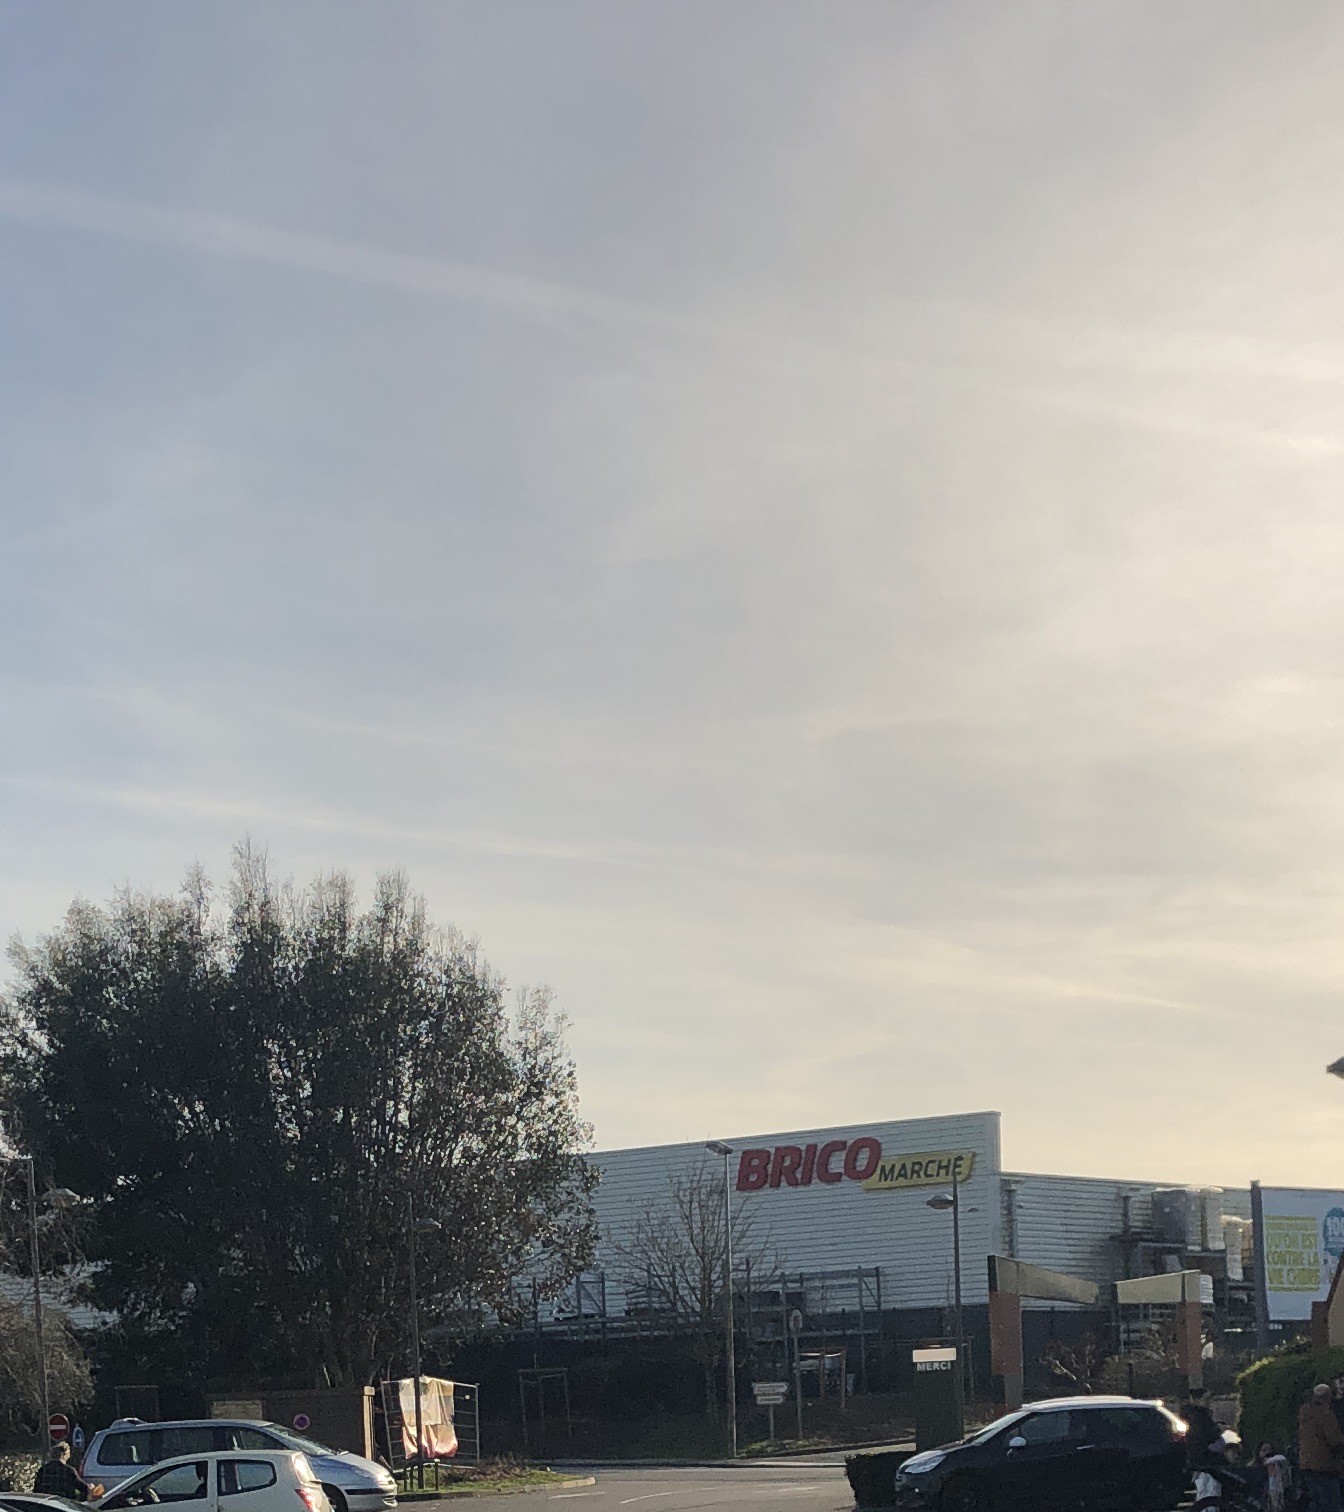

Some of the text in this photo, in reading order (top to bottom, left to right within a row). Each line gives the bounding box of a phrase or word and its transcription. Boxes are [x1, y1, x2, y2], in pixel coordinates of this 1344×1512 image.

[736, 1136, 964, 1191] BRICO MARCHÉ
[916, 1362, 952, 1371] MERCI
